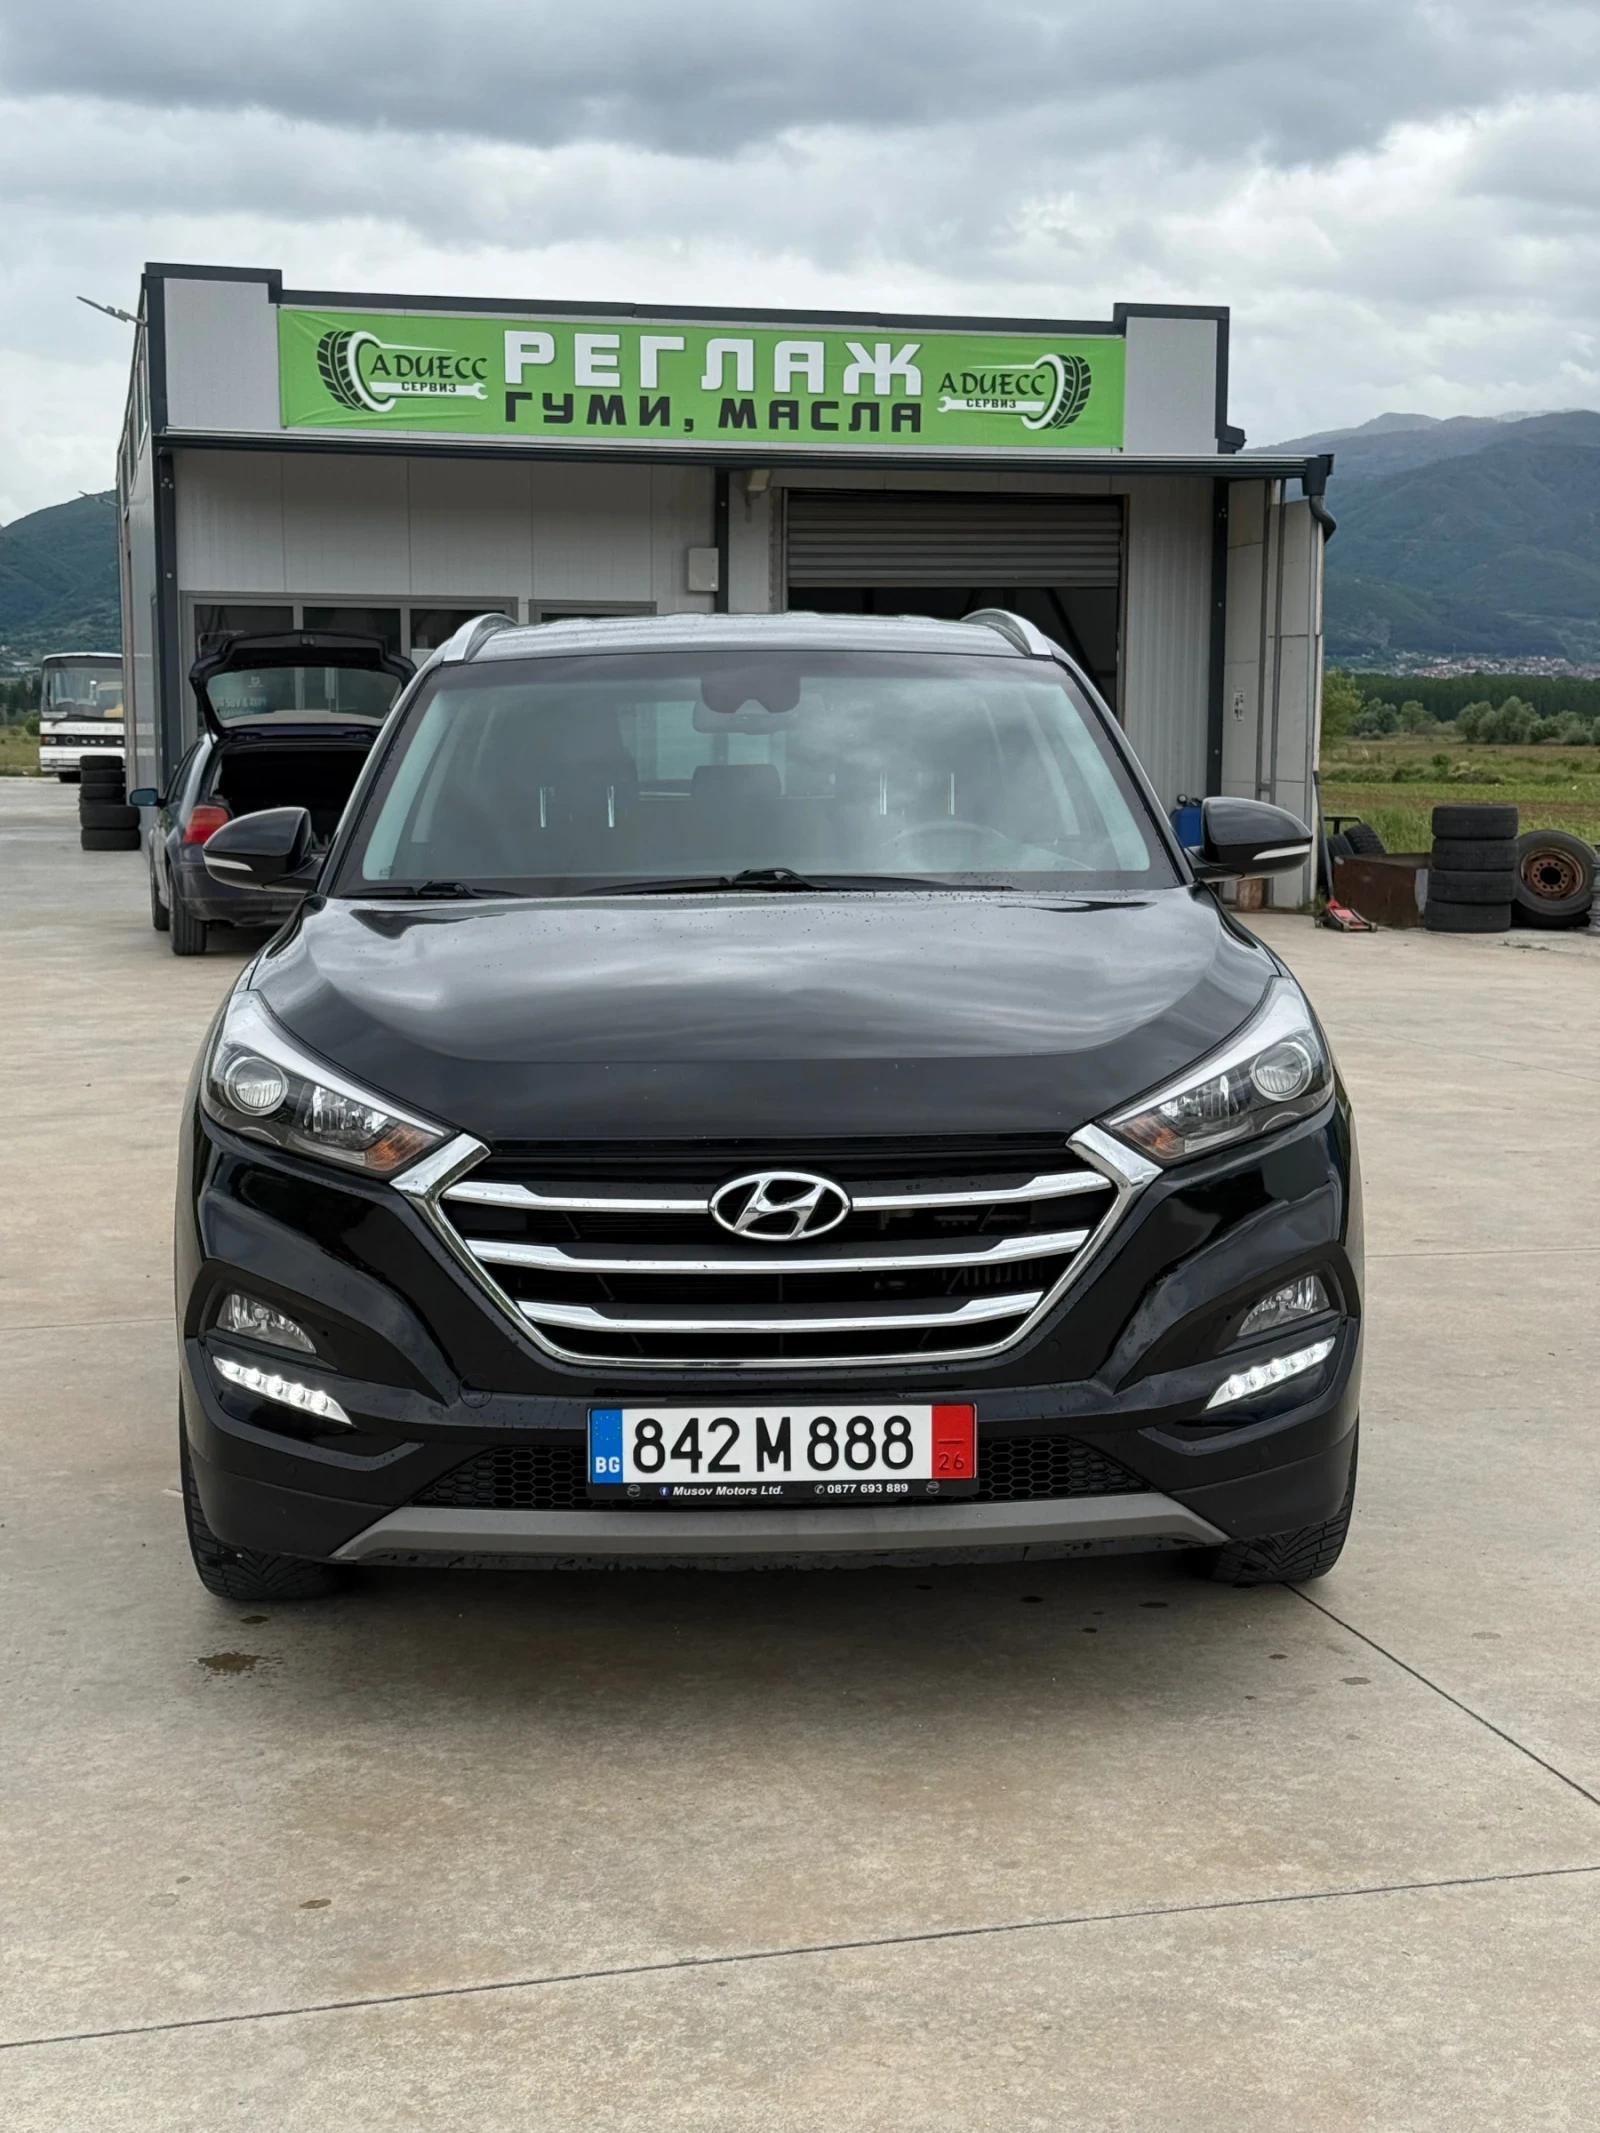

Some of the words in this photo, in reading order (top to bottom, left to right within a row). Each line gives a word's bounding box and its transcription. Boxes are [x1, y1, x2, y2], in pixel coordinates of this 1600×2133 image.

[504, 330, 922, 396] РЕГЛАЖ
[401, 381, 457, 393] СЕРВИЗ
[505, 391, 694, 433] ГУМИ,
[717, 398, 922, 433] МАСЛА
[966, 398, 1017, 409] СЕРВИЗ
[633, 1417, 740, 1474] 842
[756, 1416, 792, 1473] M
[807, 1415, 913, 1472] 888
[595, 1456, 621, 1474] BG
[938, 1453, 965, 1471] 26
[673, 1486, 713, 1496] Musov
[716, 1485, 757, 1496] Motors
[761, 1485, 784, 1495] Ltd.
[827, 1484, 857, 1494] 0877
[860, 1484, 883, 1494] 693
[886, 1483, 908, 1493] 889
